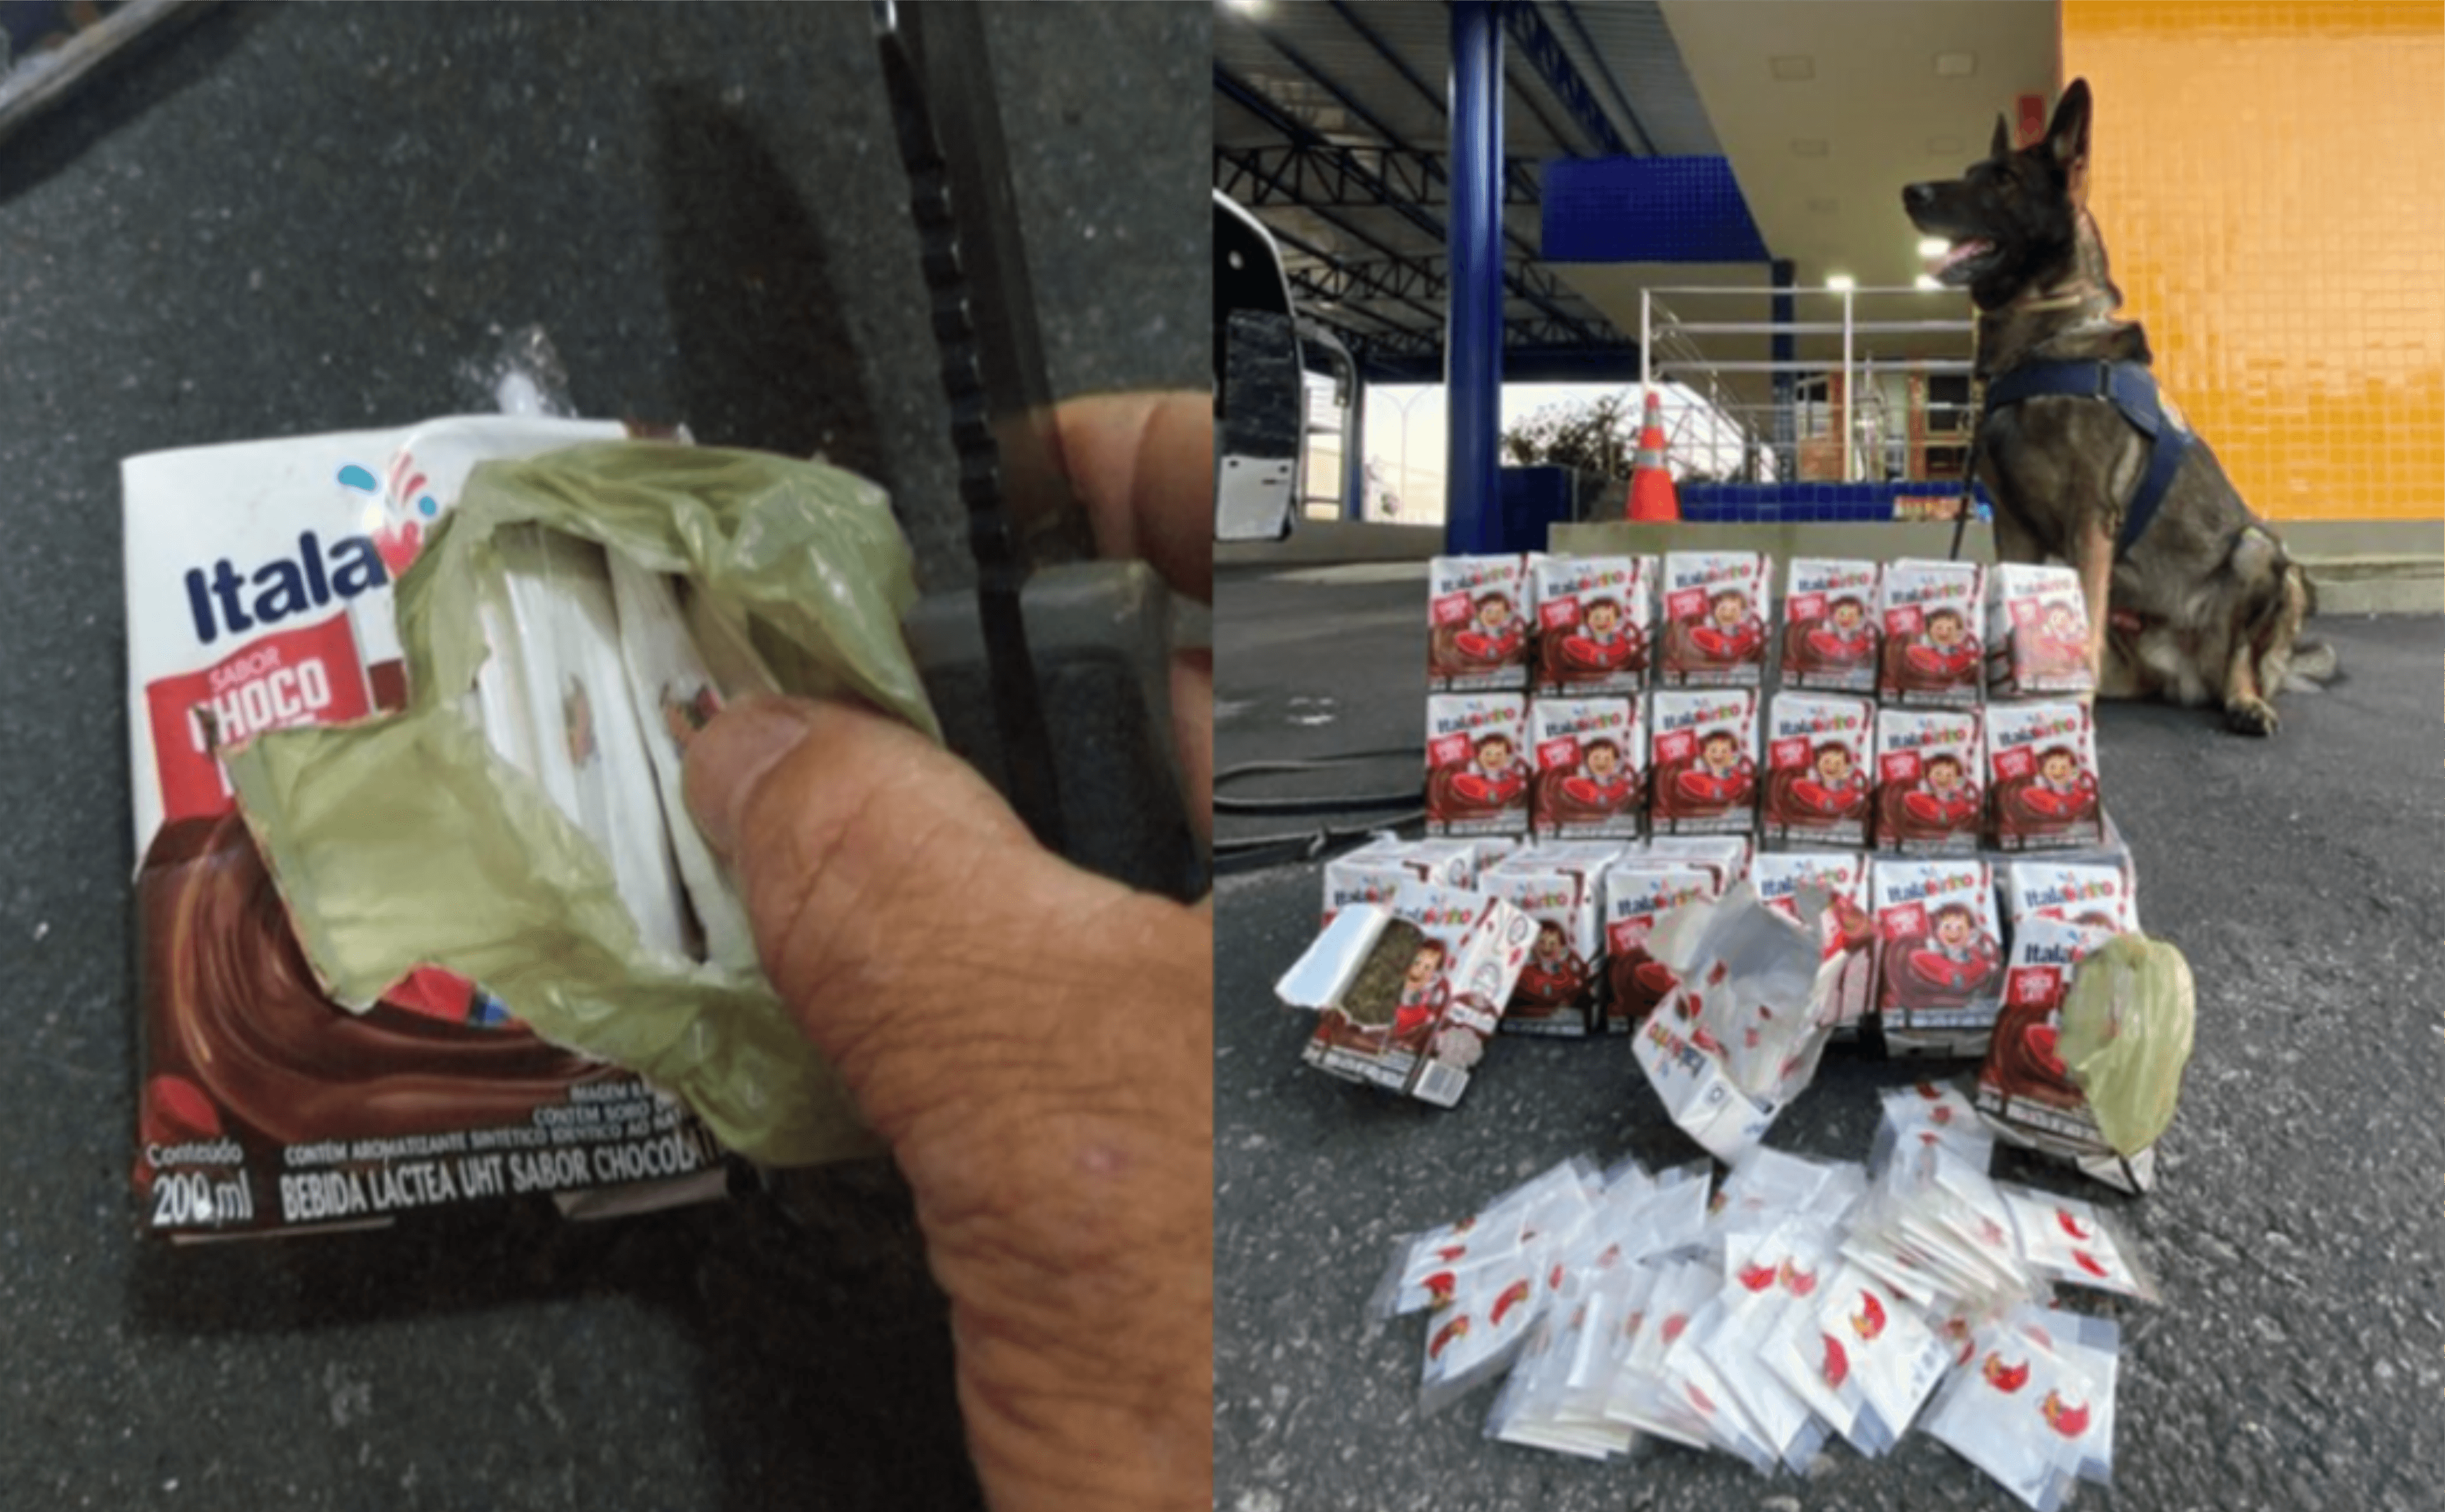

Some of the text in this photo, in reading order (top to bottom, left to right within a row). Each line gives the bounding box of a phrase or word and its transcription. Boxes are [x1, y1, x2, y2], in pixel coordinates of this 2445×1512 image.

[209, 645, 280, 692] SABOR
[152, 1171, 213, 1226] 200
[280, 1170, 368, 1222] BEBIDA
[457, 1154, 504, 1198] UHT
[509, 1147, 592, 1194] SABOR
